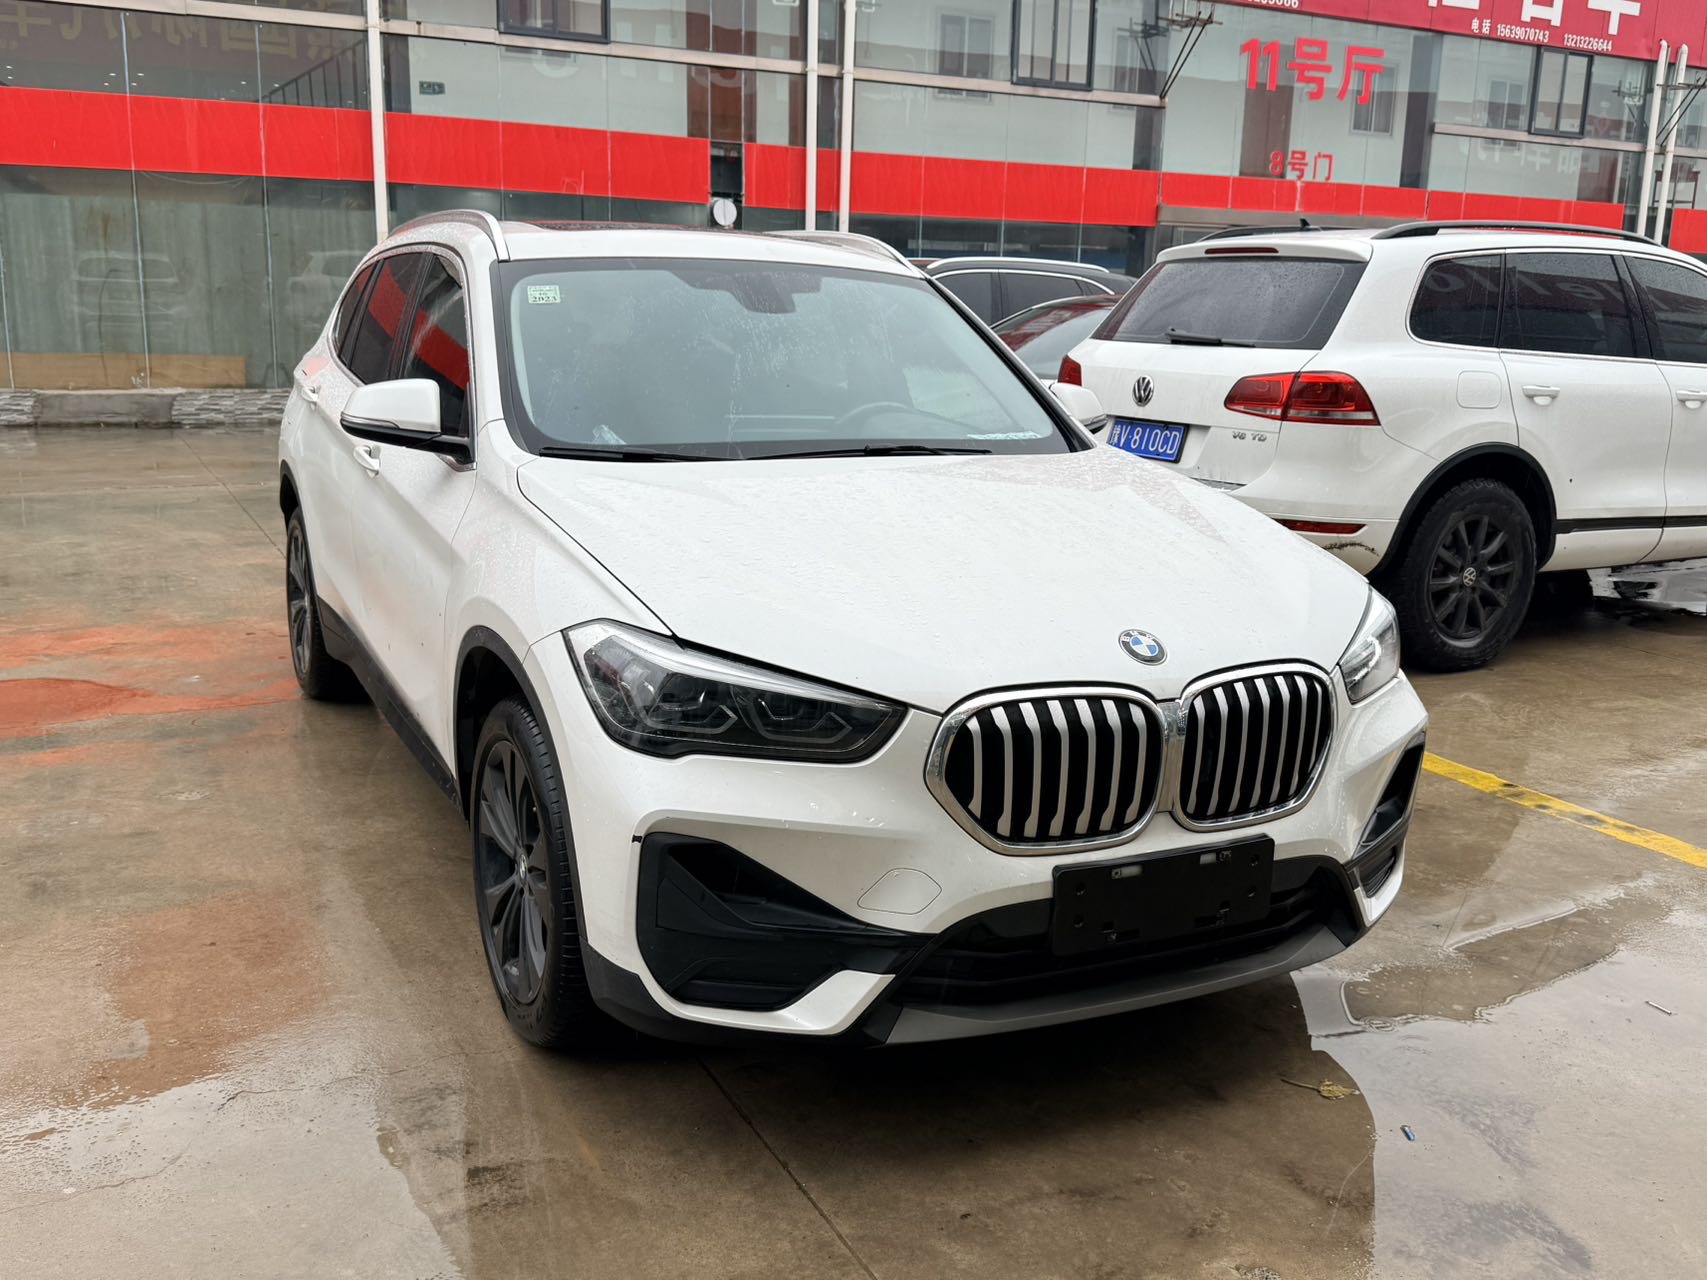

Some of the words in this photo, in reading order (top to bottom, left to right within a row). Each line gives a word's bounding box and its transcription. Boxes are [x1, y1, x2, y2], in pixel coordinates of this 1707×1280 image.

[1471, 17, 1491, 34] 电话
[1497, 24, 1549, 43] 15639070743
[1240, 38, 1386, 106] 11号厅
[1270, 150, 1333, 182] 8号门
